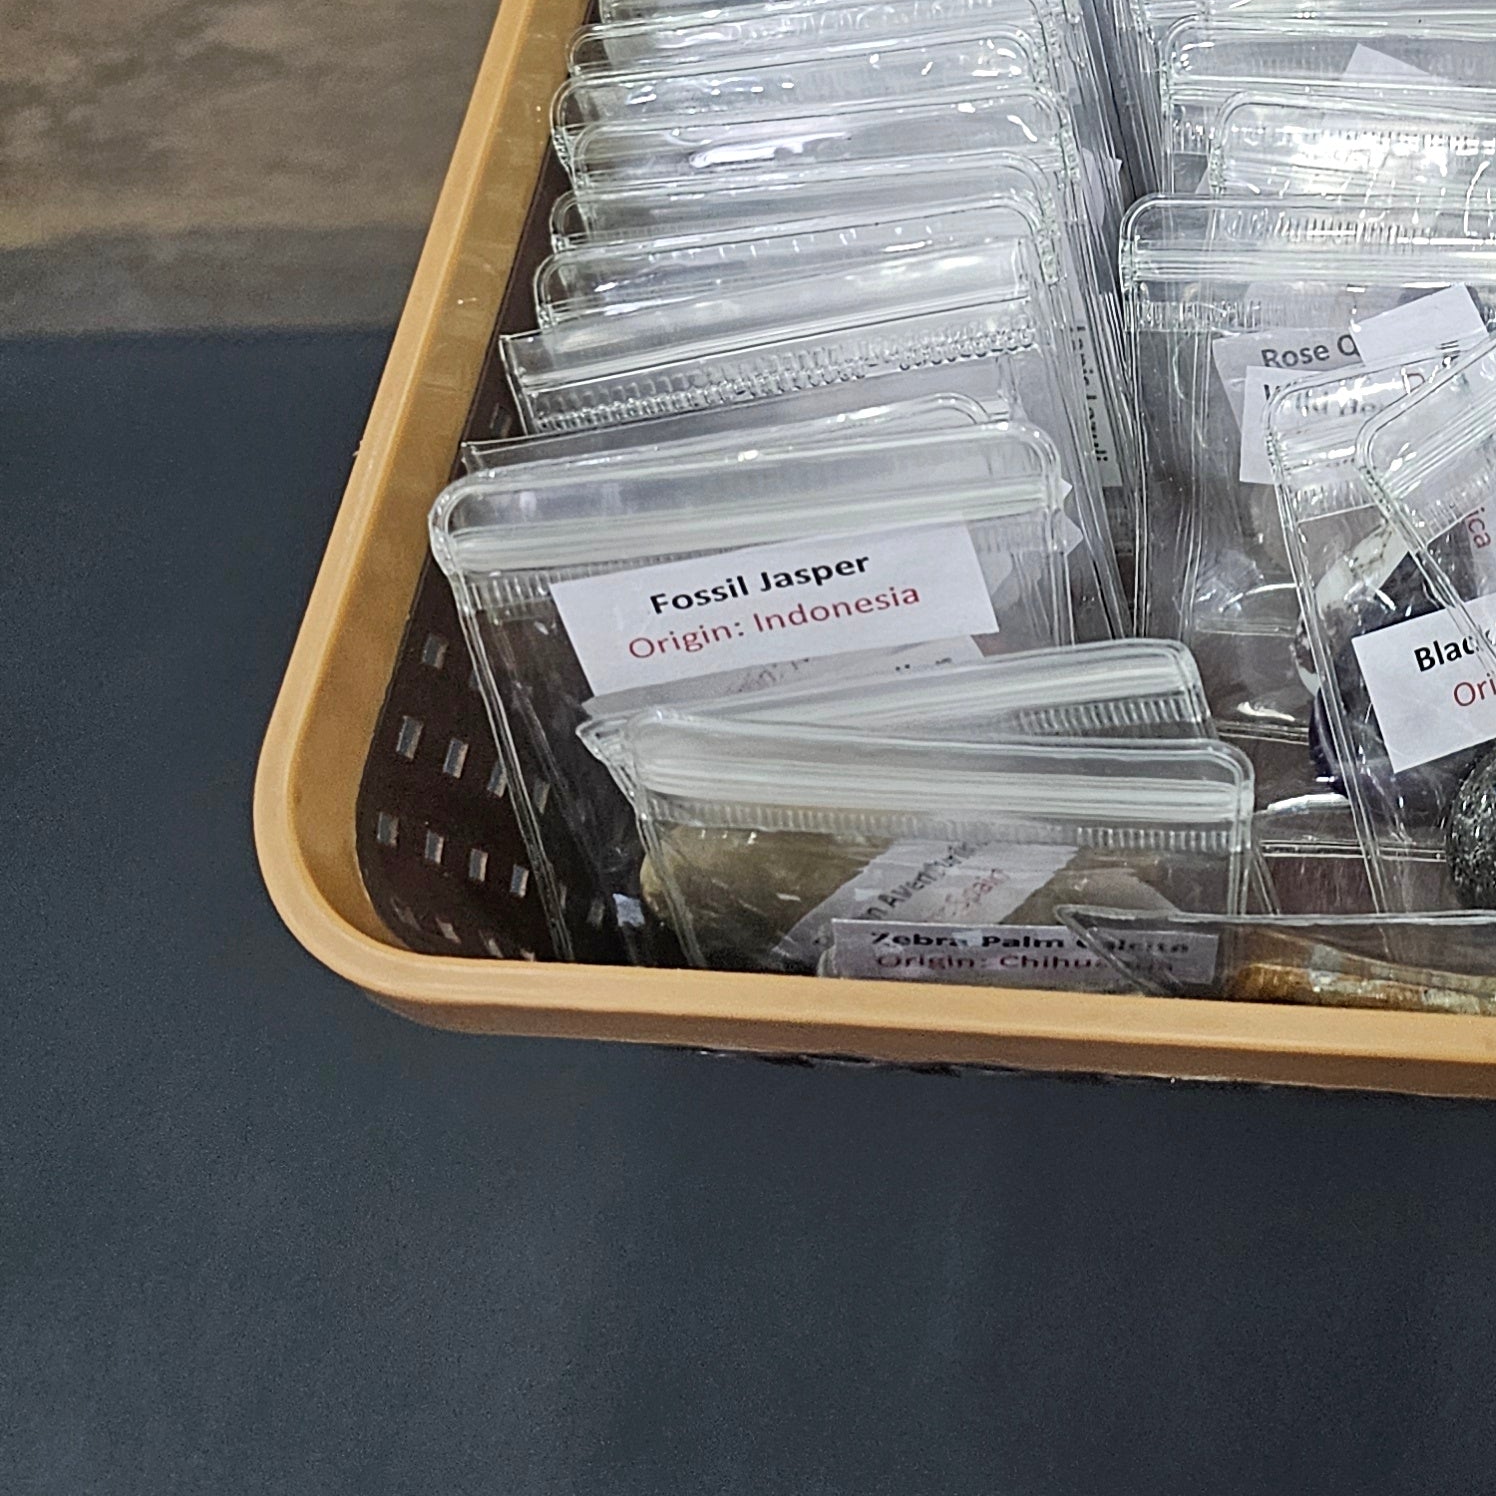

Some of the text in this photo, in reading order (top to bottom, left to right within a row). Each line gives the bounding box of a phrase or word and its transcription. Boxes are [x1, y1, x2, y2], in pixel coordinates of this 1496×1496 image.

[1260, 343, 1330, 368] Rose
[650, 555, 870, 614] Fossil Jasper
[628, 583, 921, 661] Origin: Indonesia
[871, 931, 968, 948] Zebra
[982, 933, 1064, 950] Palm
[877, 954, 988, 970] Origin:
